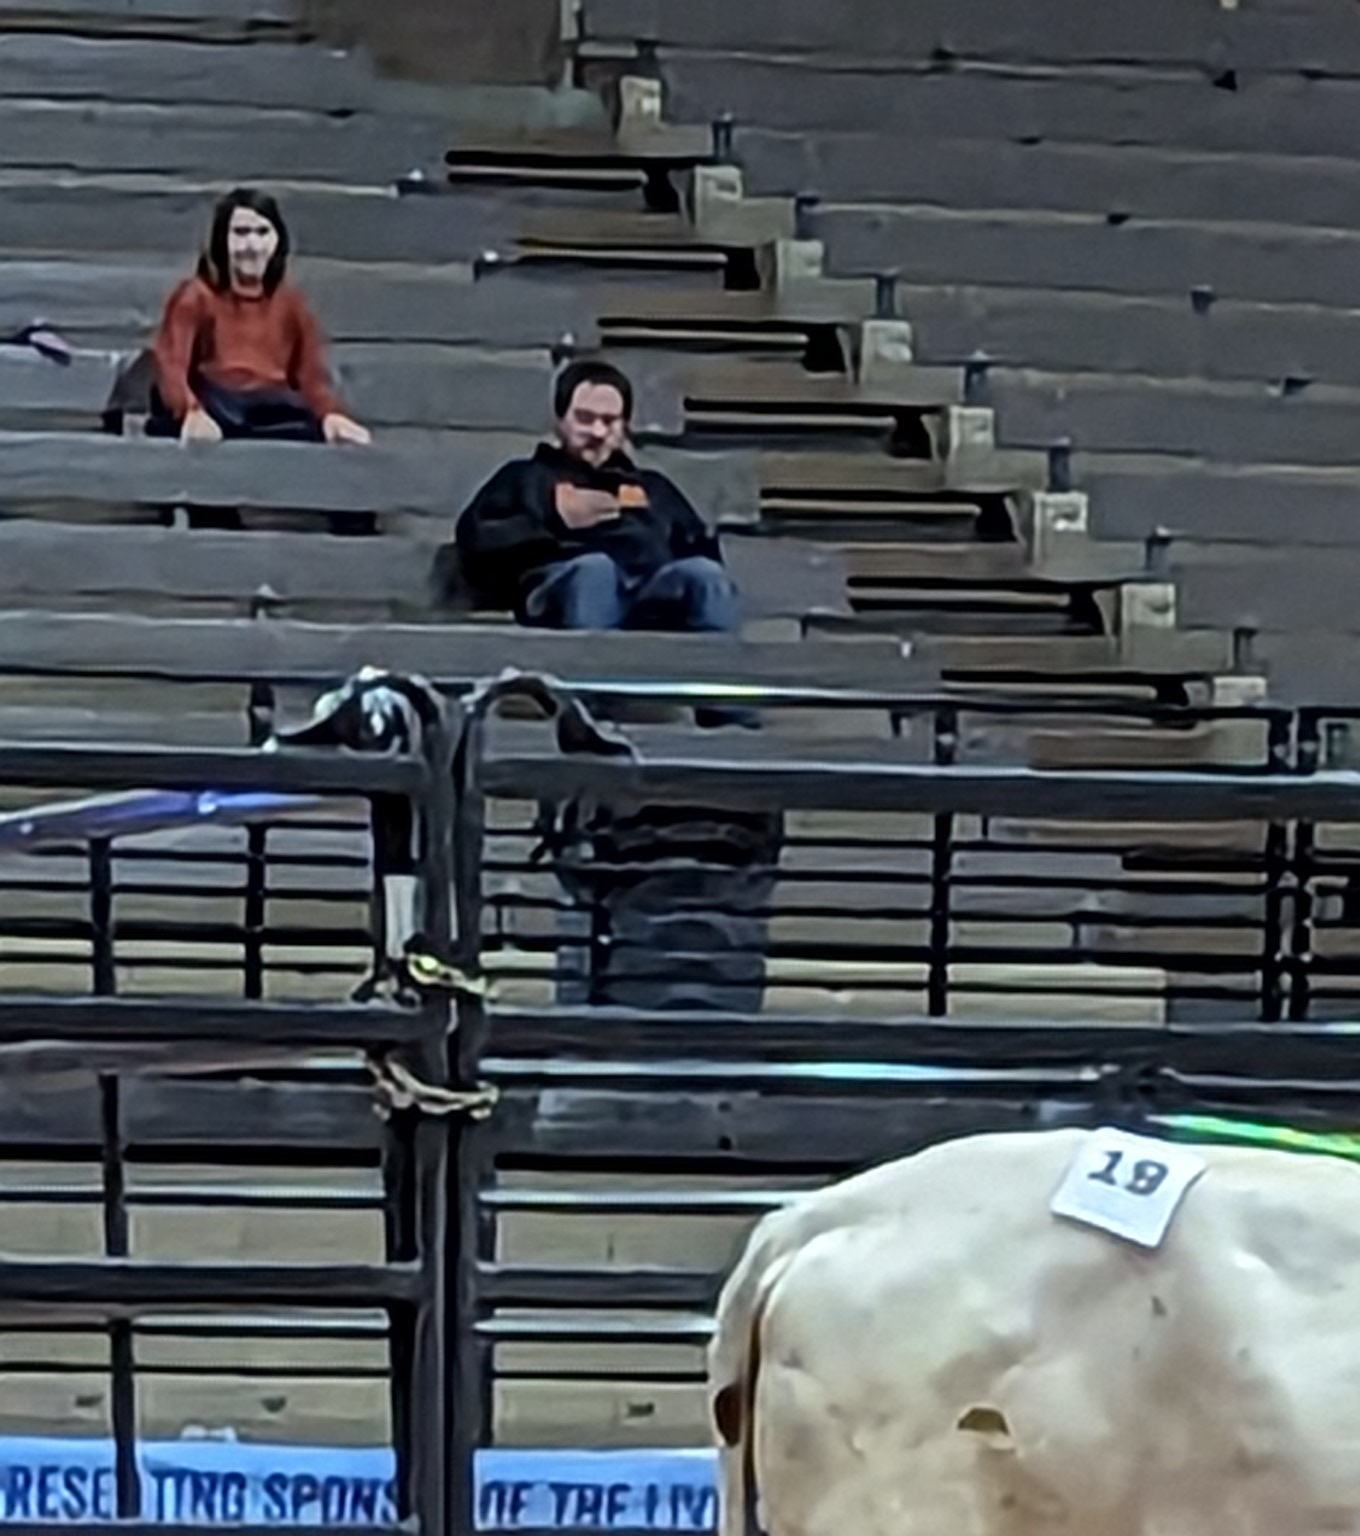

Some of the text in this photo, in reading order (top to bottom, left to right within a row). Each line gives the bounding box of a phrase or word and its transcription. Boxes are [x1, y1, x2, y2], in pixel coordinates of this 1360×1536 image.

[0, 1465, 247, 1522] RESETING
[480, 1480, 533, 1526] OF
[548, 1481, 633, 1526] THE
